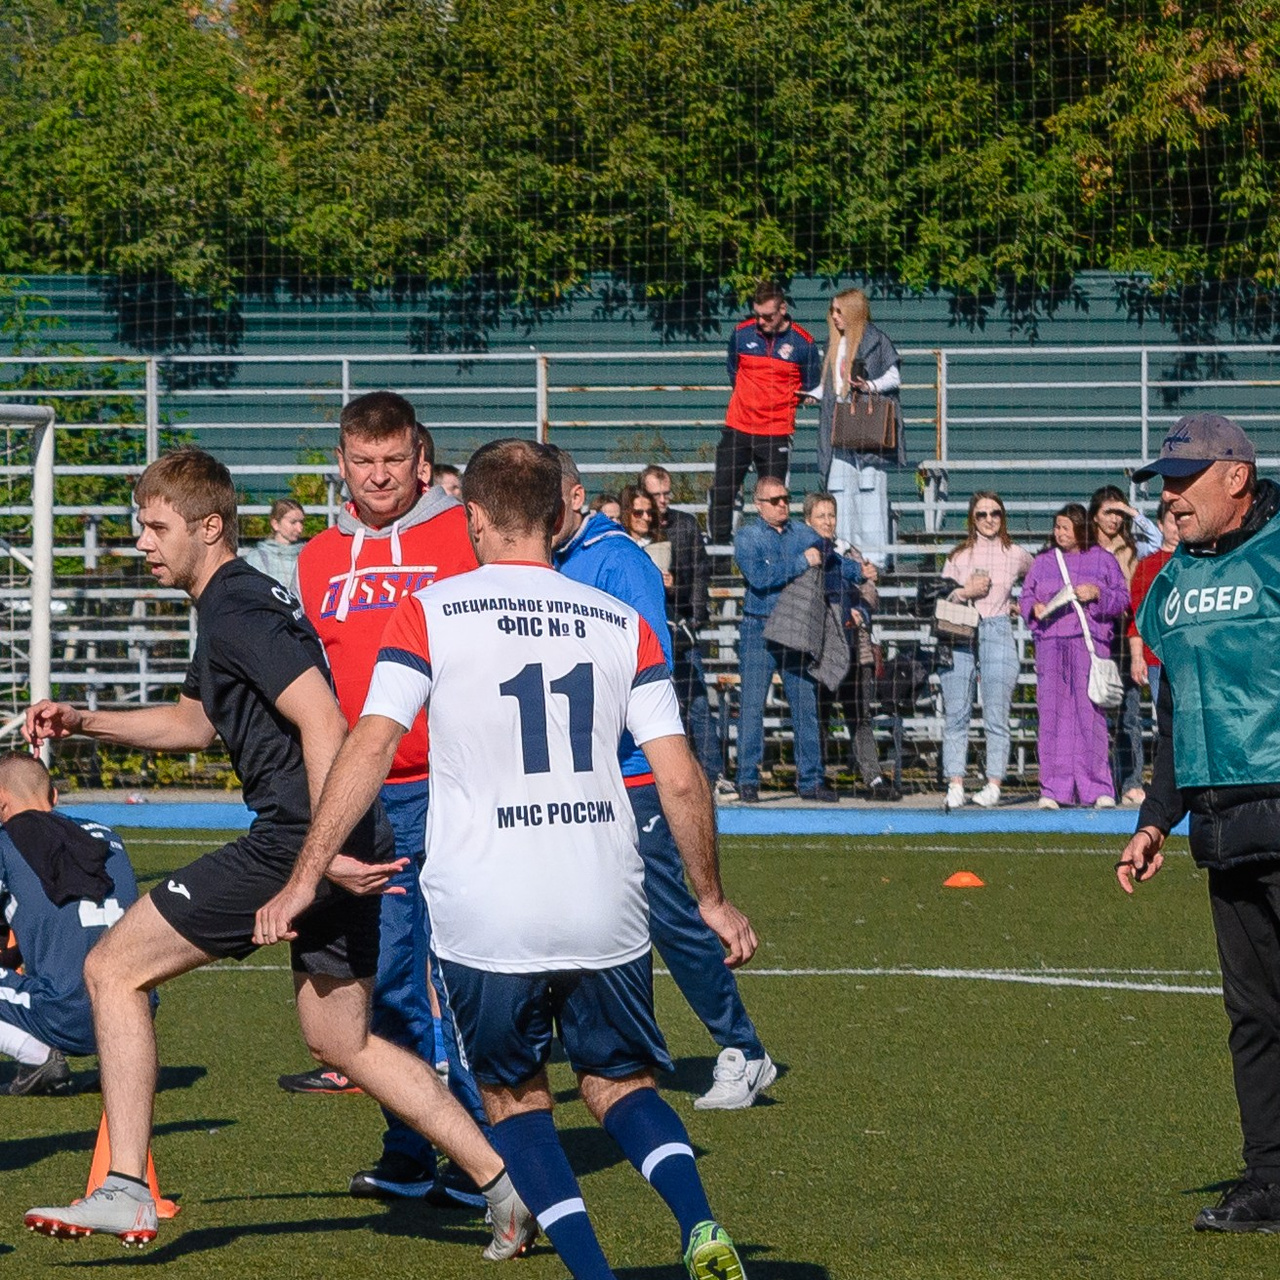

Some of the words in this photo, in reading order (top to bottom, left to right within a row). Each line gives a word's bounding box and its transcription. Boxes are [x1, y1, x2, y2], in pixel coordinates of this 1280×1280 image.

[443, 598, 543, 616] СПЕЦИАЛЬНОЕ
[546, 600, 627, 630] УПРАВЛЕНИЕ
[1184, 586, 1253, 614] СБЕР
[498, 615, 543, 637] ФПС
[548, 618, 570, 637] №
[574, 620, 586, 638] 8
[499, 662, 594, 775] 11
[497, 803, 542, 829] МЧС
[547, 800, 615, 825] РОССИИ
